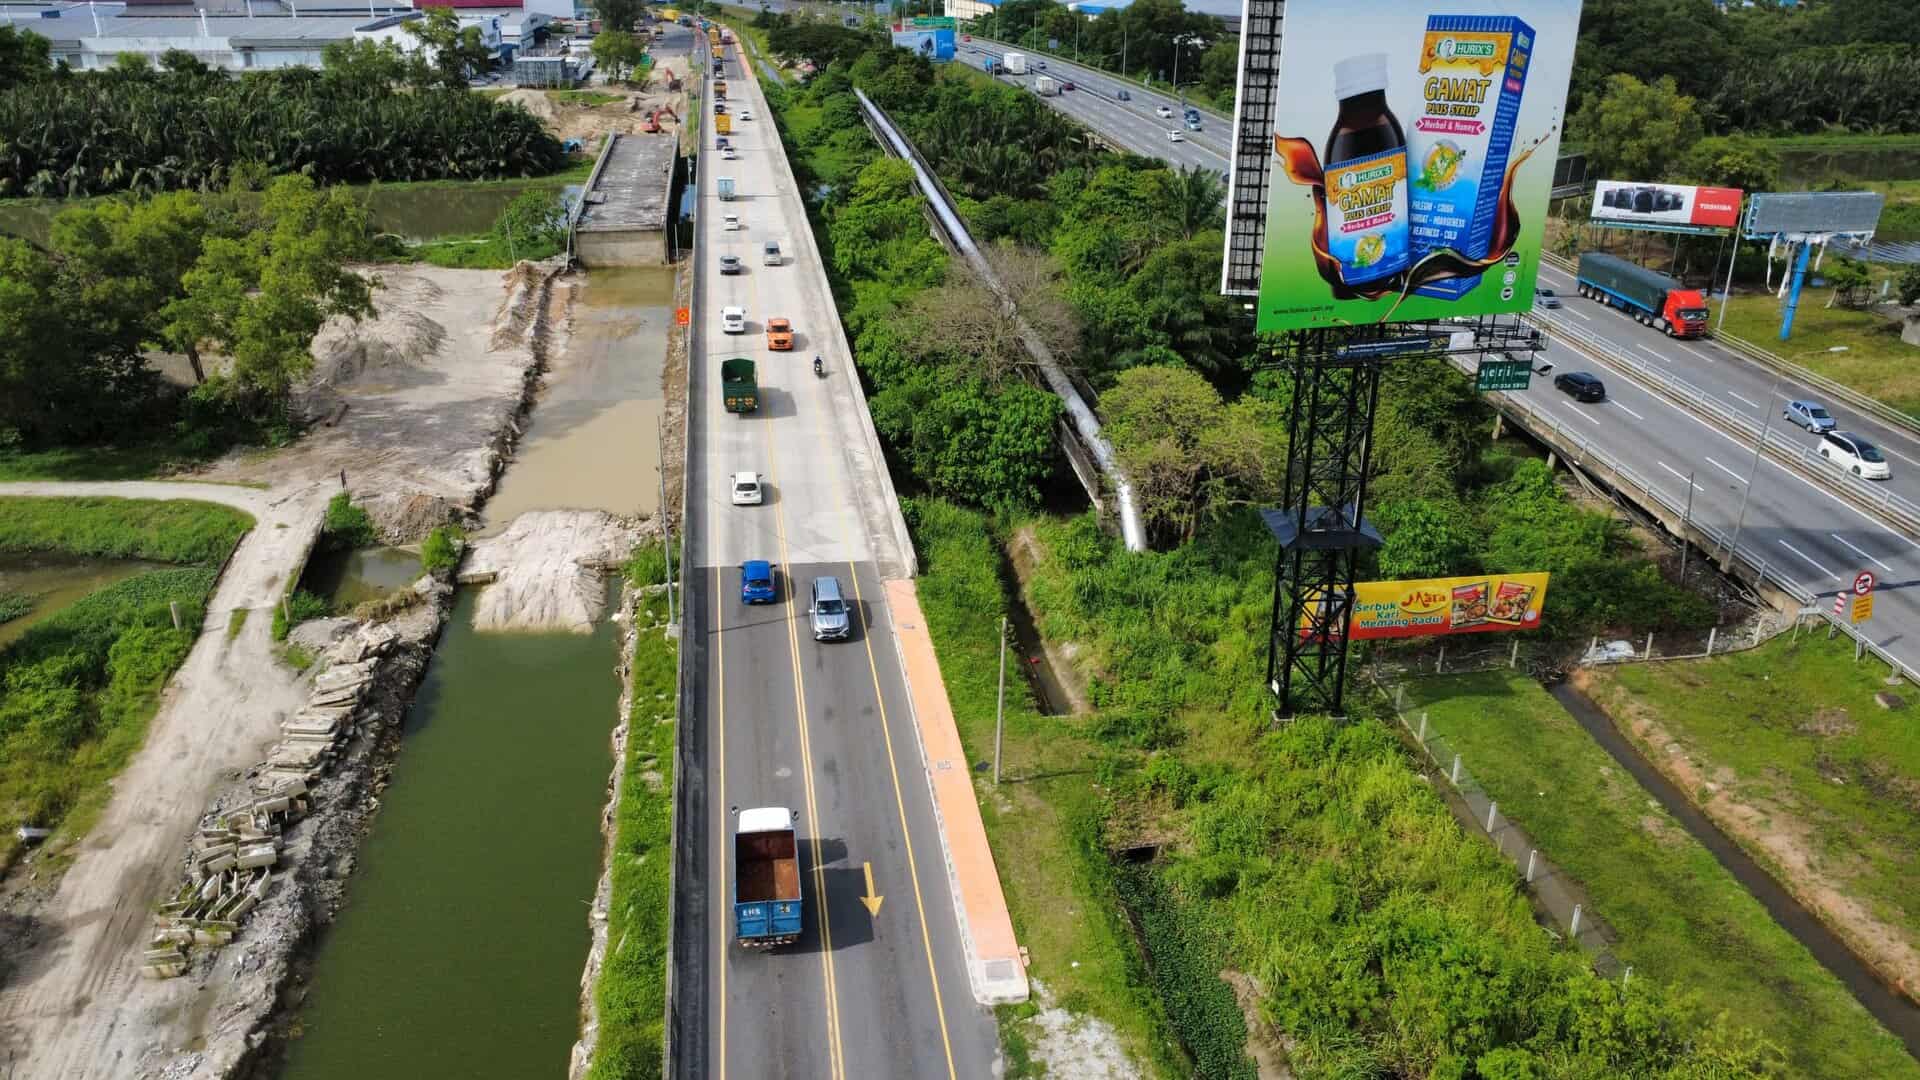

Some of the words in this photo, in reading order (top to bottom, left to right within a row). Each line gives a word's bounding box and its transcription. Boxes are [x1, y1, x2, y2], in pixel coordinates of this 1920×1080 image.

[1456, 42, 1492, 55] HURIX'S
[1424, 76, 1491, 103] GAMAT
[1425, 103, 1449, 115] PLUS
[1449, 104, 1480, 117] SYRUP
[1339, 182, 1396, 212] GAMAT
[1355, 602, 1396, 611] Serbuk
[1376, 610, 1400, 619] Kari
[1360, 618, 1409, 629] Memang
